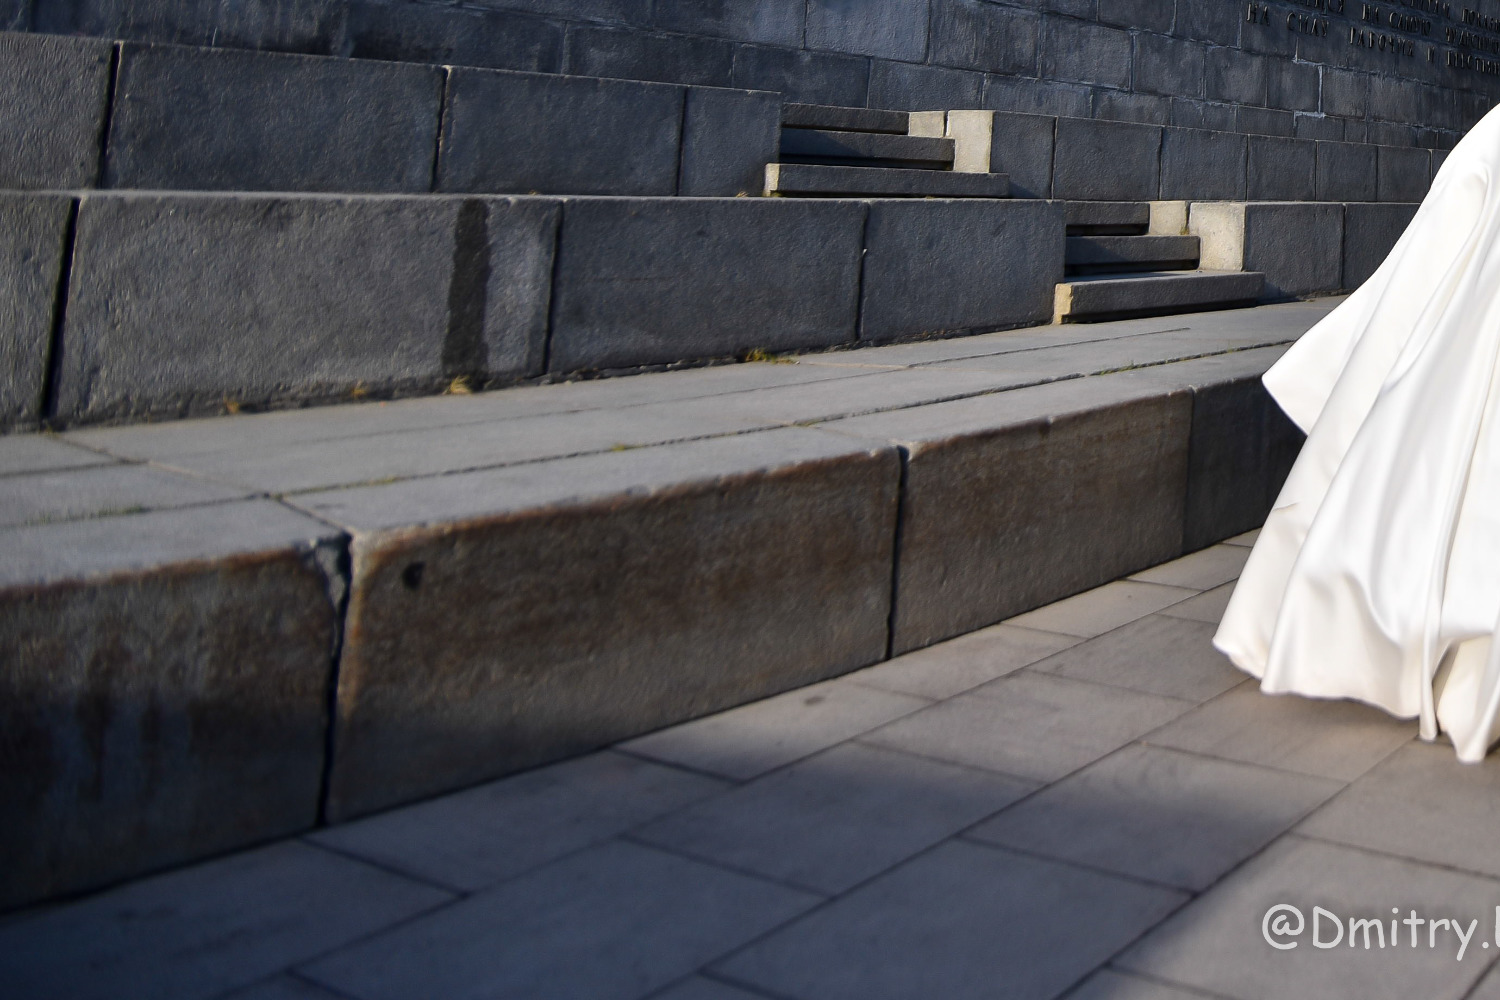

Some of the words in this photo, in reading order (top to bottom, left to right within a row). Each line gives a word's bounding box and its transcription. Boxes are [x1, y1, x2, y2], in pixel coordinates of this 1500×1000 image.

[1246, 3, 1270, 27] НА
[1286, 12, 1329, 38] СИЛУ
[1349, 26, 1415, 58] РАБОЧИХ
[1362, 3, 1379, 22] НА
